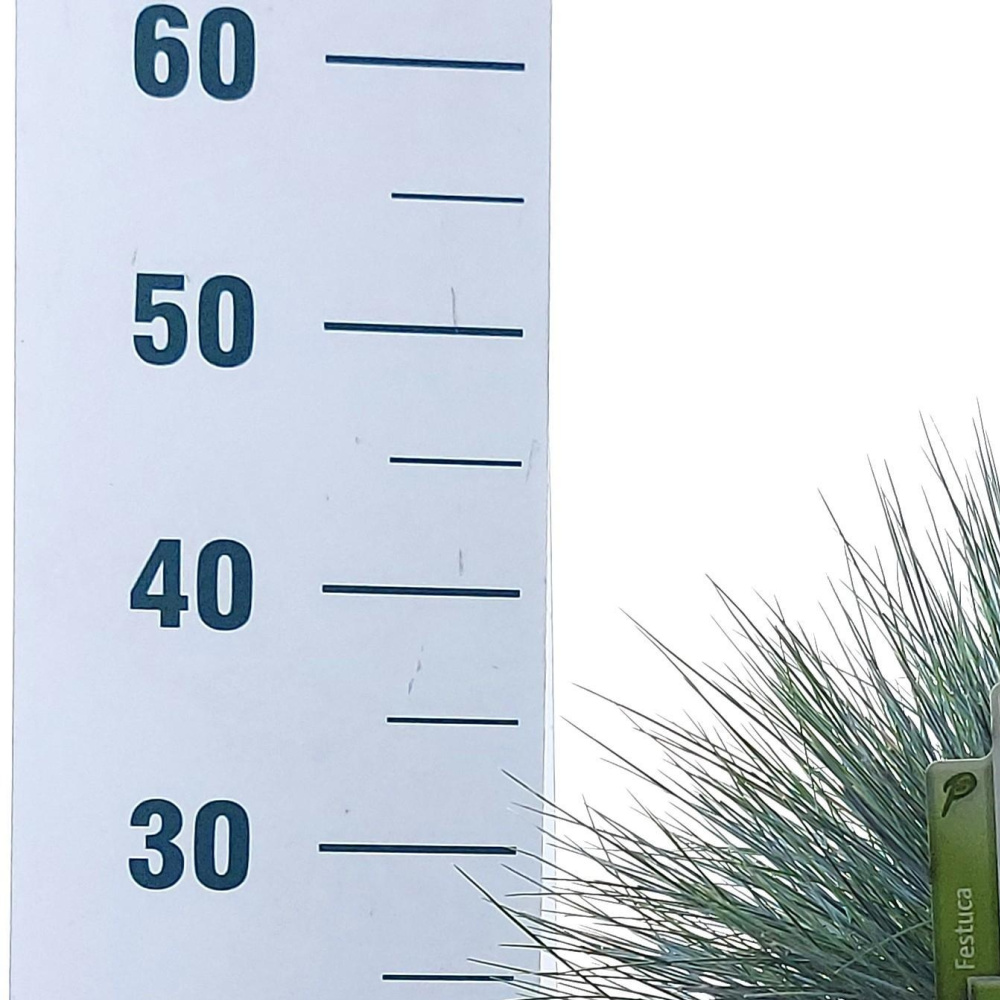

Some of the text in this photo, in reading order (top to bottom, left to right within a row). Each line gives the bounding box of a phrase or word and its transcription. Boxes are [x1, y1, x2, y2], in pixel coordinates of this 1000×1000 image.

[134, 4, 256, 101] 60
[133, 273, 255, 368] 50
[129, 538, 253, 631] 40
[128, 798, 250, 891] 30
[955, 887, 975, 970] Festuca
